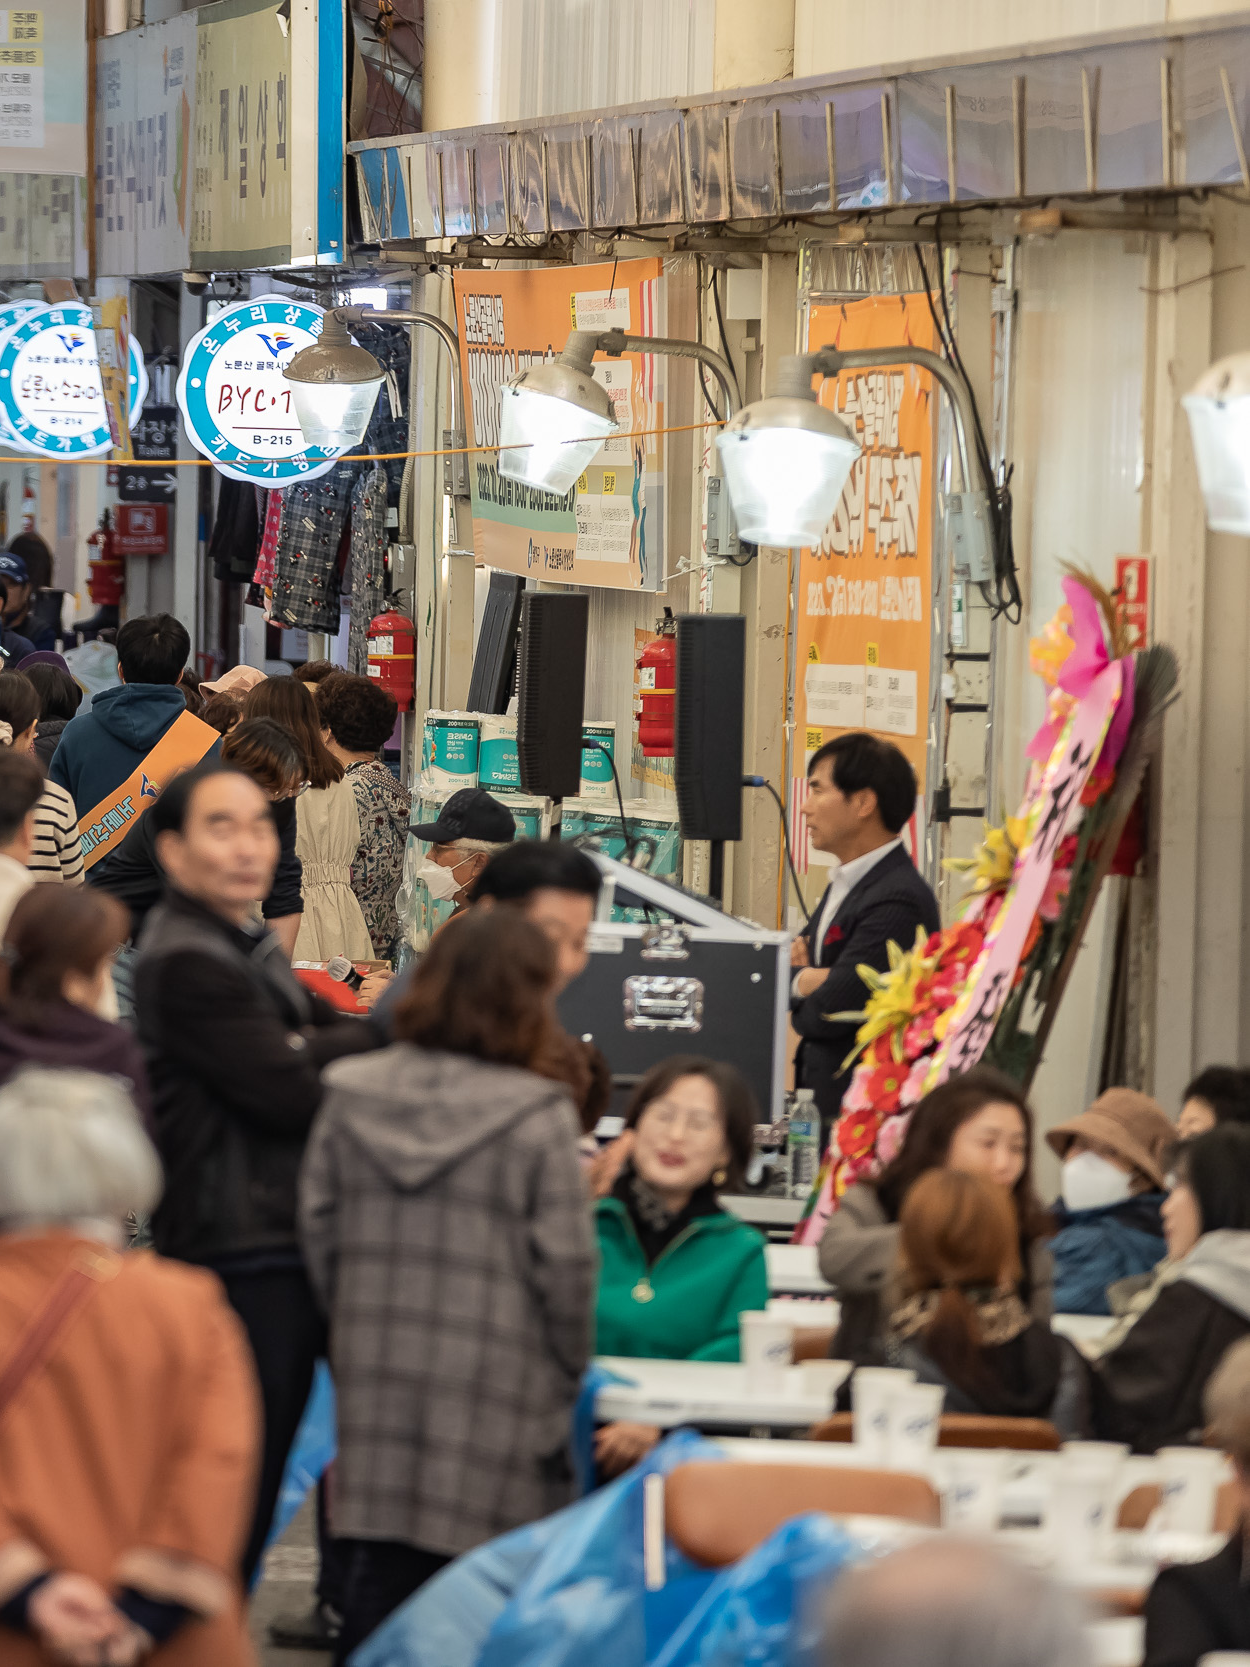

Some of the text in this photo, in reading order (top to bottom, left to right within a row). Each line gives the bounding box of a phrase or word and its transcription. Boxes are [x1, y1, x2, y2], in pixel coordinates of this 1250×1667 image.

[218, 71, 287, 199] 제일상회
[224, 360, 253, 371] 노룬산
[253, 435, 292, 445] B-215
[137, 444, 170, 457] Toilet
[447, 732, 474, 741] 크리넥스
